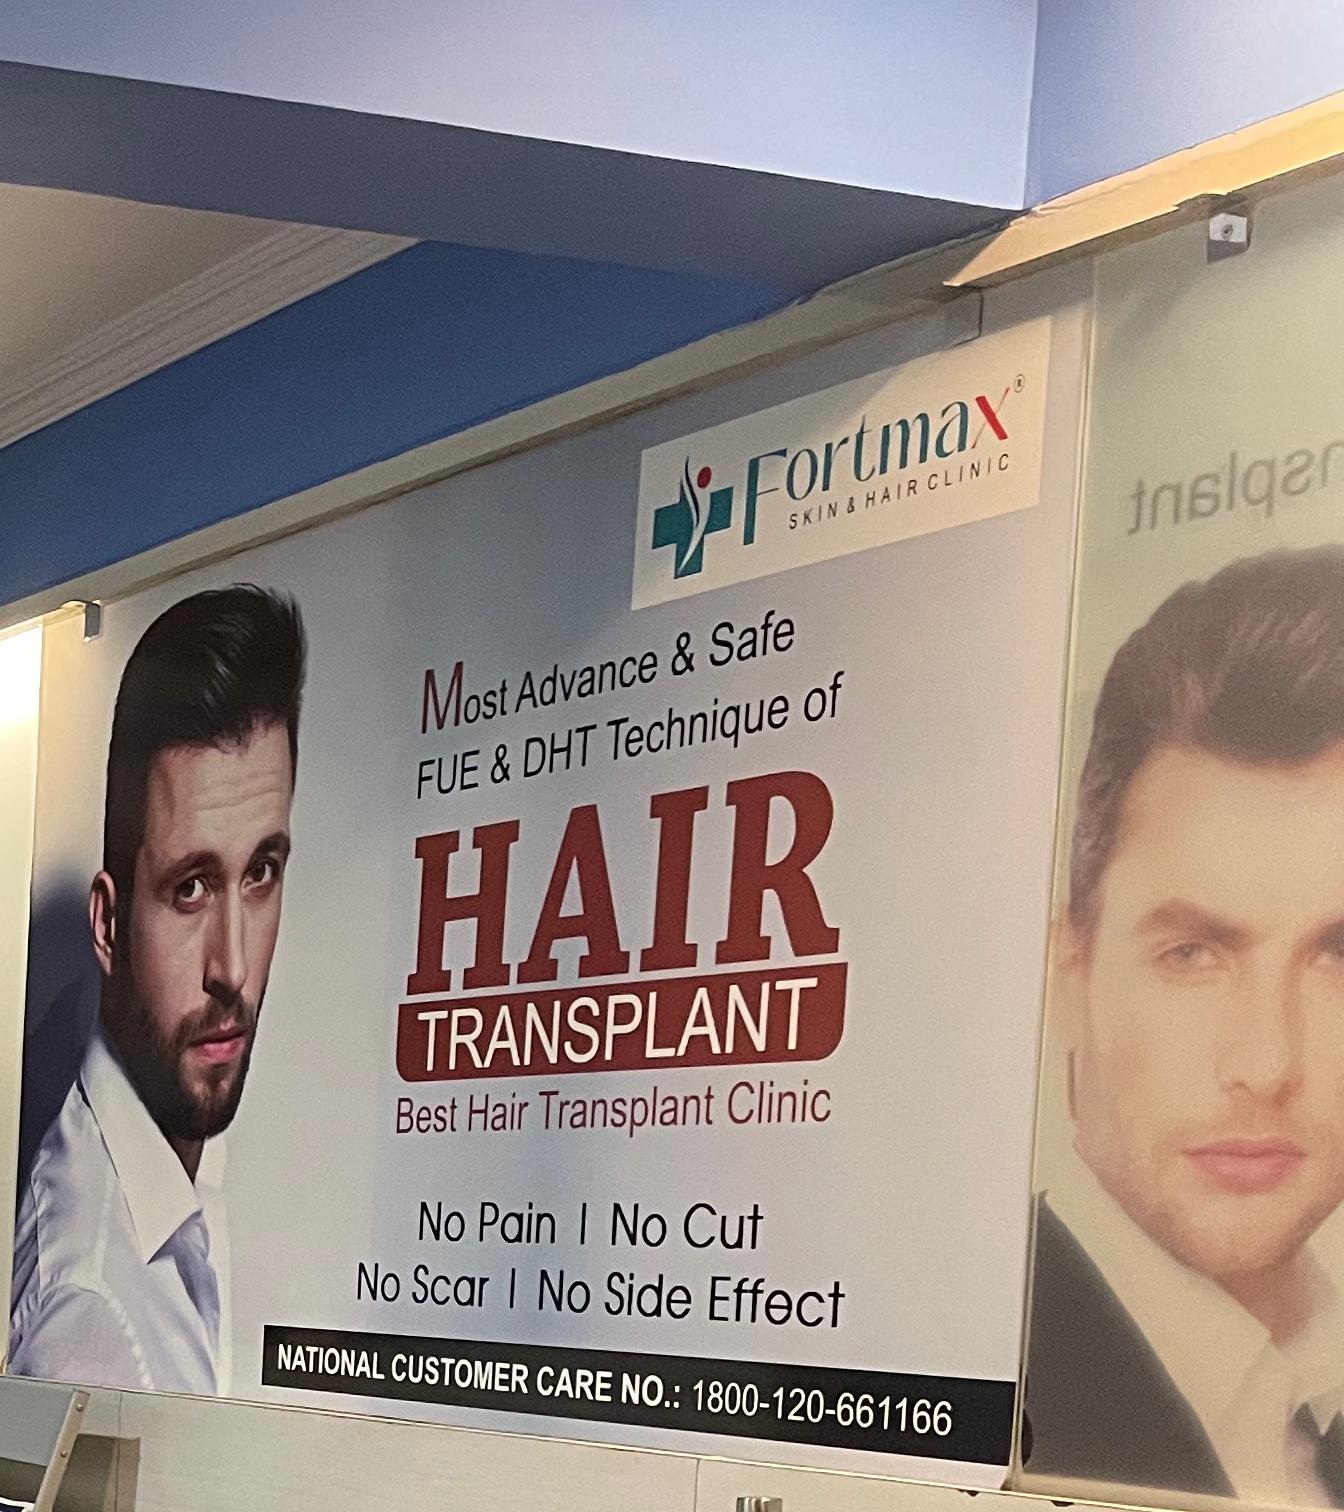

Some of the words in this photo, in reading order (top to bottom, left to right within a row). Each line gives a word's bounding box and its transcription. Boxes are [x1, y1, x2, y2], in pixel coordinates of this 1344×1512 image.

[788, 499, 839, 530] SKIN
[846, 496, 857, 512] &
[864, 479, 919, 508] HAIR
[927, 453, 1011, 491] CLINIC
[419, 660, 508, 734] Most
[514, 648, 658, 714] Advance
[670, 632, 696, 674] &
[709, 609, 797, 667] Safe
[415, 749, 482, 799] FUE
[490, 745, 512, 784] &
[522, 725, 598, 779] DHT
[607, 690, 790, 762] Technique
[803, 671, 846, 723] of
[407, 770, 840, 997] HAIR
[417, 977, 819, 1073] TRANSPLANT
[395, 1096, 457, 1135] Best
[467, 1092, 529, 1132] Hair
[537, 1084, 715, 1138] Transplant
[727, 1079, 832, 1125] Clinic
[418, 1201, 466, 1245] No
[479, 1200, 558, 1246] Pain
[610, 1203, 668, 1249] No
[683, 1202, 765, 1251] Cut
[357, 1262, 402, 1303] No
[411, 1264, 490, 1309] Scar
[538, 1270, 591, 1313] No
[604, 1272, 692, 1319] Side
[709, 1276, 846, 1328] Effect
[277, 1343, 385, 1380] NATIONAL
[391, 1353, 529, 1394] CUSTOMER
[536, 1366, 612, 1402] CARE
[620, 1372, 681, 1409] NO.:
[692, 1377, 953, 1436] 1800-120-661166
